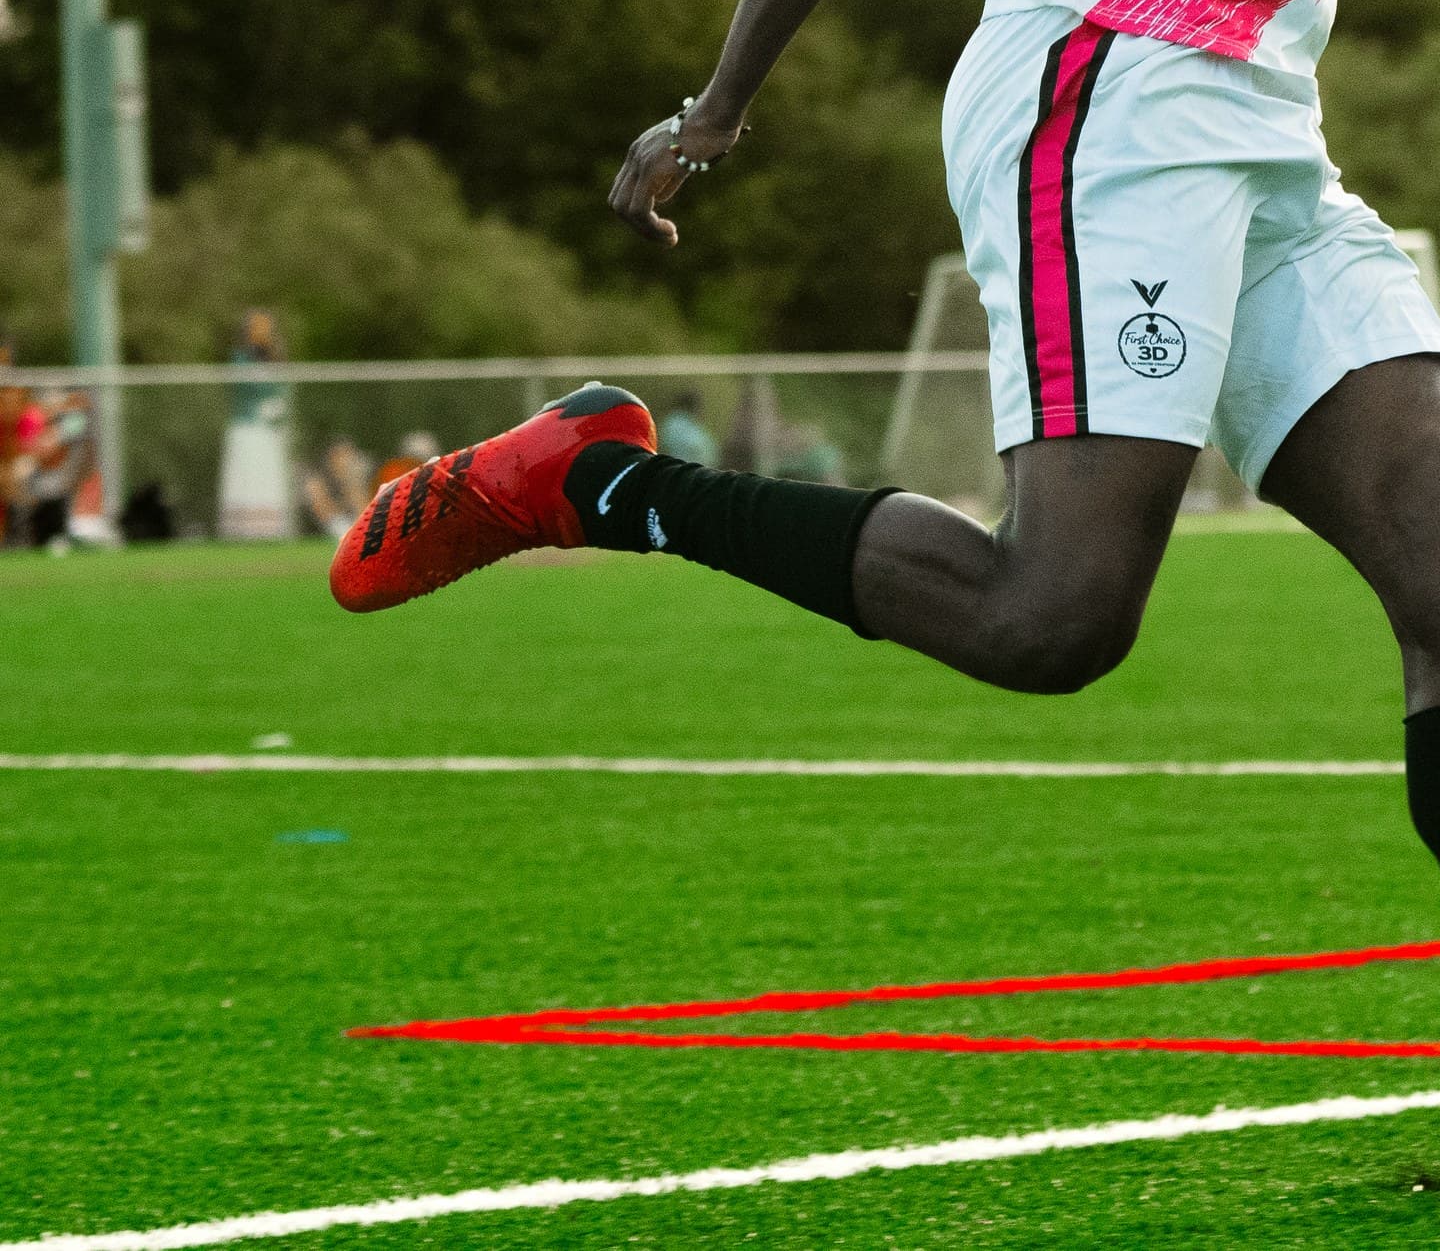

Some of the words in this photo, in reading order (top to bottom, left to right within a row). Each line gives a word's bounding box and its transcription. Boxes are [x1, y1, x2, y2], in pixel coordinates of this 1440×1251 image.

[1124, 331, 1148, 346] First
[1149, 333, 1181, 346] Choice
[1138, 346, 1168, 361] 3D
